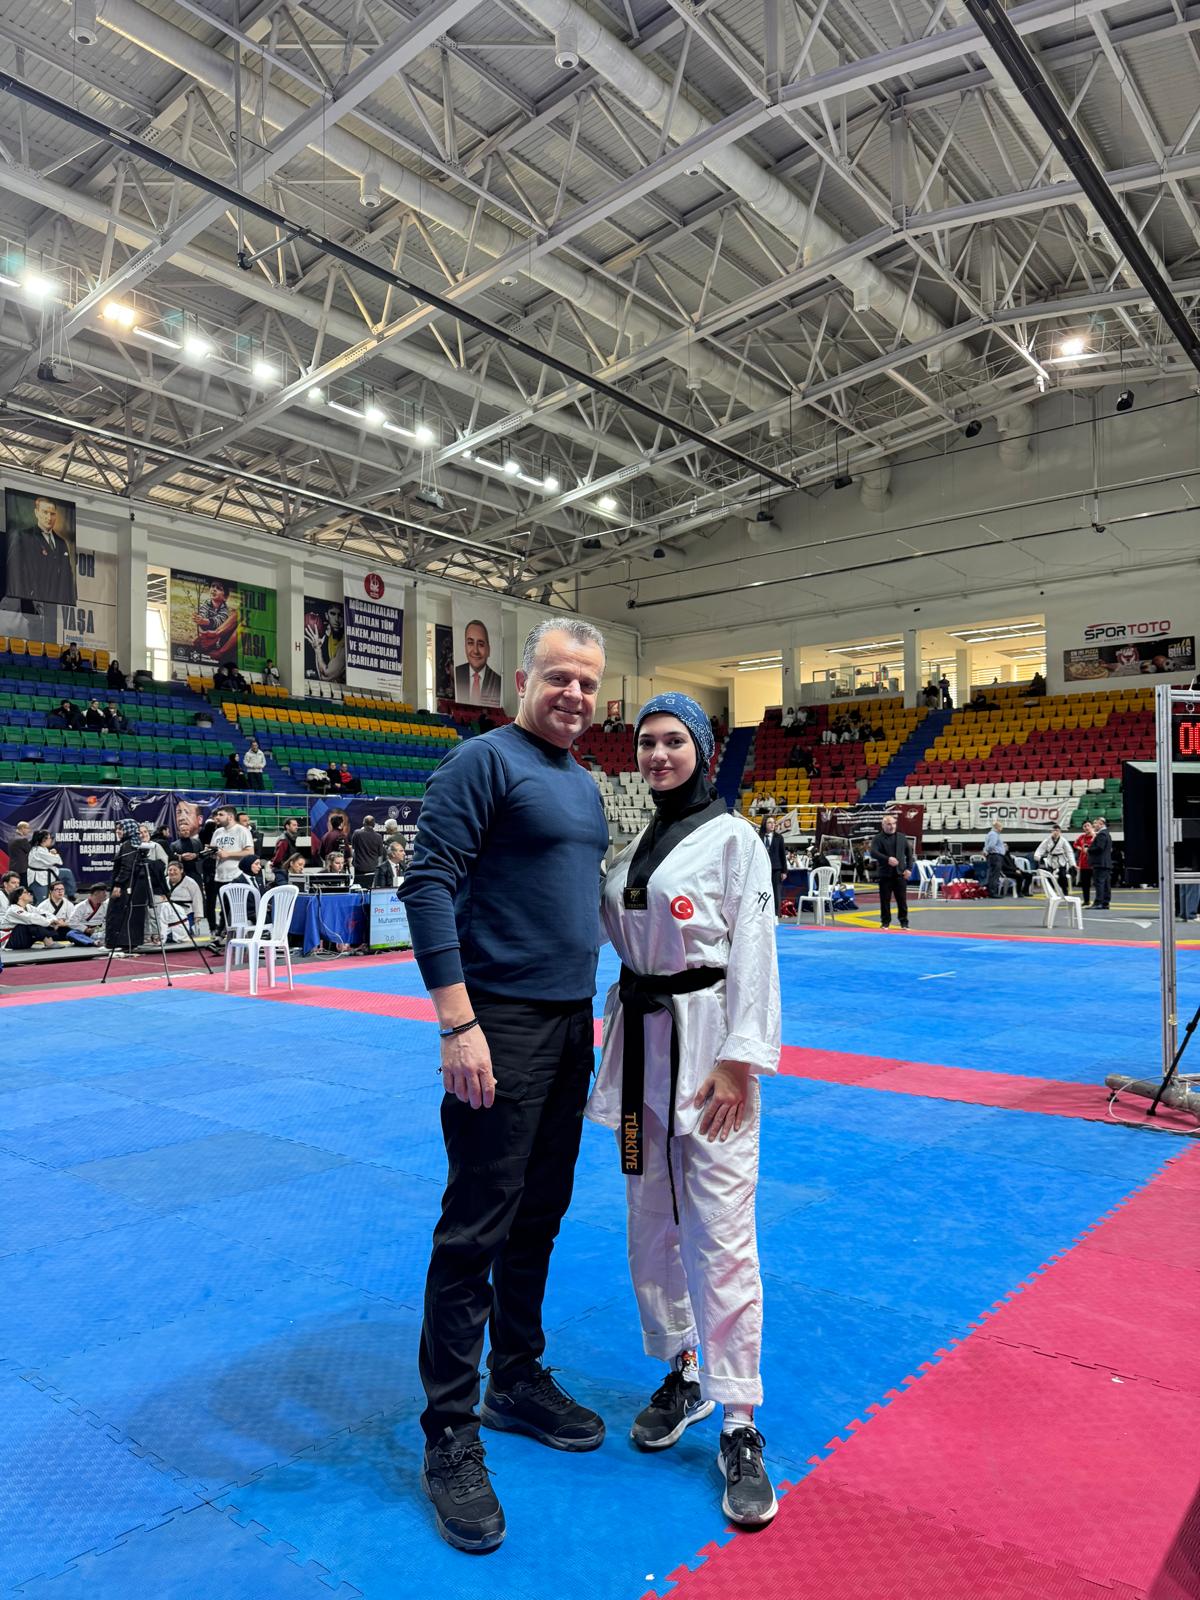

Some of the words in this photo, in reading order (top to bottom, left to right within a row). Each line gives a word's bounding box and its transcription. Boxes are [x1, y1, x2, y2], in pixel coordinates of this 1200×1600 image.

[61, 604, 95, 635] YAŞA
[354, 613, 380, 628] KATILAN
[381, 619, 394, 632] TÜM
[295, 641, 302, 651] H
[349, 639, 357, 651] VE
[358, 642, 398, 659] SPORCULARA
[63, 818, 115, 830] MÜSABAKALARA
[56, 832, 82, 842] HAKEM,
[82, 831, 115, 842] ANTRENÖR
[80, 844, 114, 856] BAŞARILAR
[625, 1112, 639, 1170] TÜRKİYE
